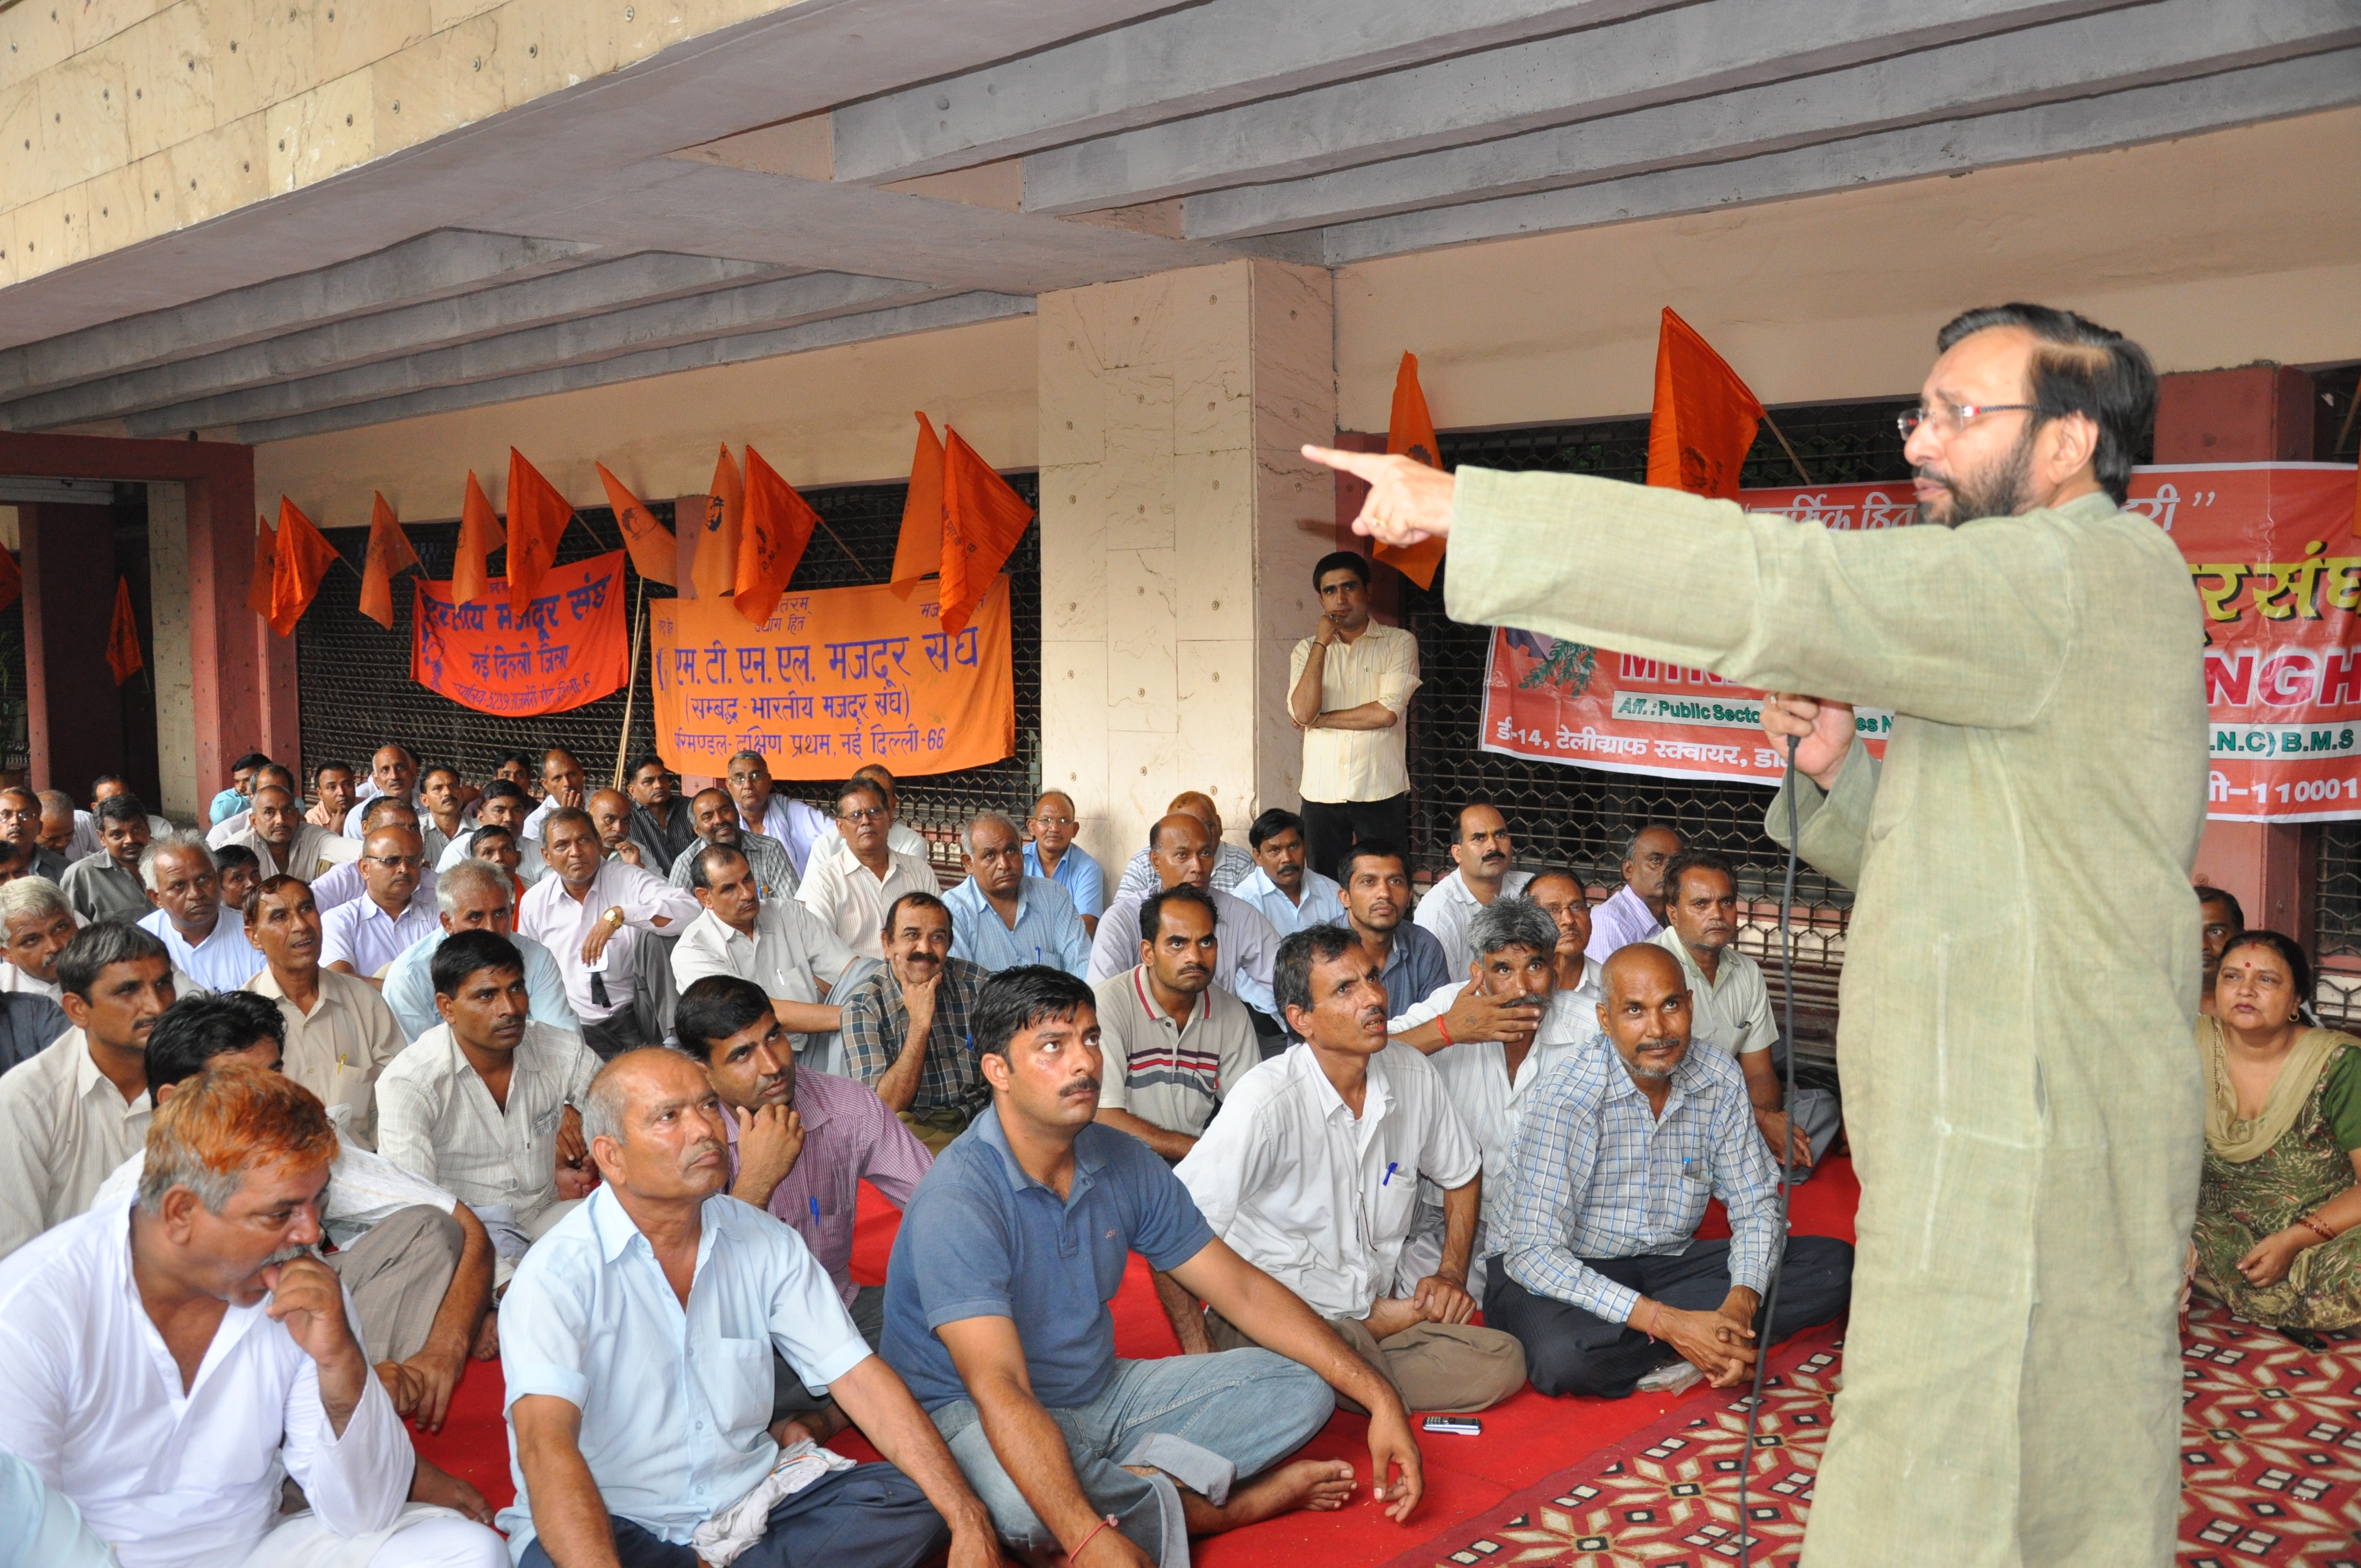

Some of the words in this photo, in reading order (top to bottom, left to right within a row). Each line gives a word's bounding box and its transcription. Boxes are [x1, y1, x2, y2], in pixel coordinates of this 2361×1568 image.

[787, 613, 806, 635] हित
[469, 644, 490, 683] नई
[493, 641, 532, 682] दिल्ली
[824, 636, 911, 688] मजदूर
[822, 693, 869, 727] मजदूर
[874, 683, 910, 722] संघ)
[1658, 699, 1711, 720] Public
[1712, 704, 1762, 724] Secto
[839, 726, 863, 760] नई
[1555, 723, 1649, 755] टेलीग्राफ
[2281, 729, 2354, 753] B.M.S
